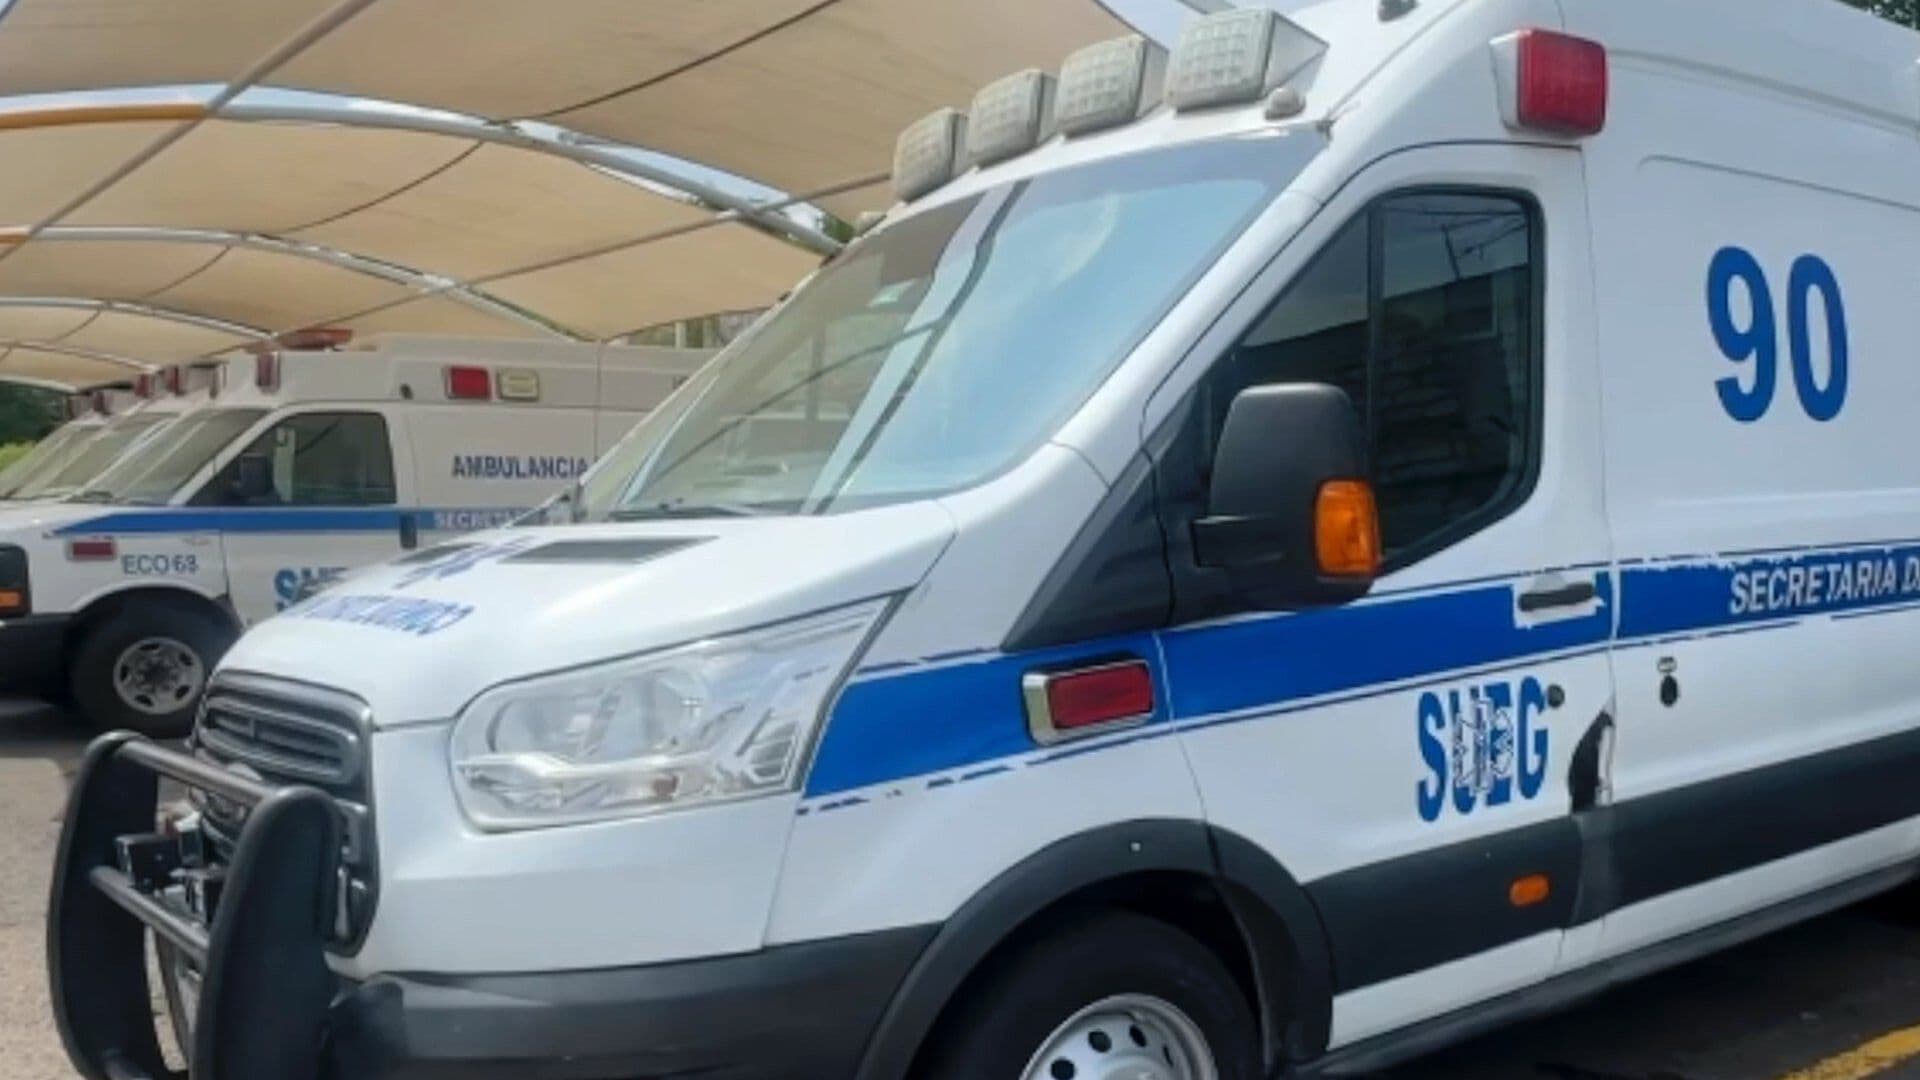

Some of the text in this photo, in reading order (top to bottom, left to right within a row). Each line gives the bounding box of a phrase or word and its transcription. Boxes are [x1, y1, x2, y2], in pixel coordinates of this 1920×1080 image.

[1706, 245, 1849, 422] 90
[452, 454, 588, 478] AMBULANCIA
[120, 553, 169, 576] ECO
[1730, 556, 1920, 615] SECRETARIA D
[1417, 675, 1550, 823] SUEG
